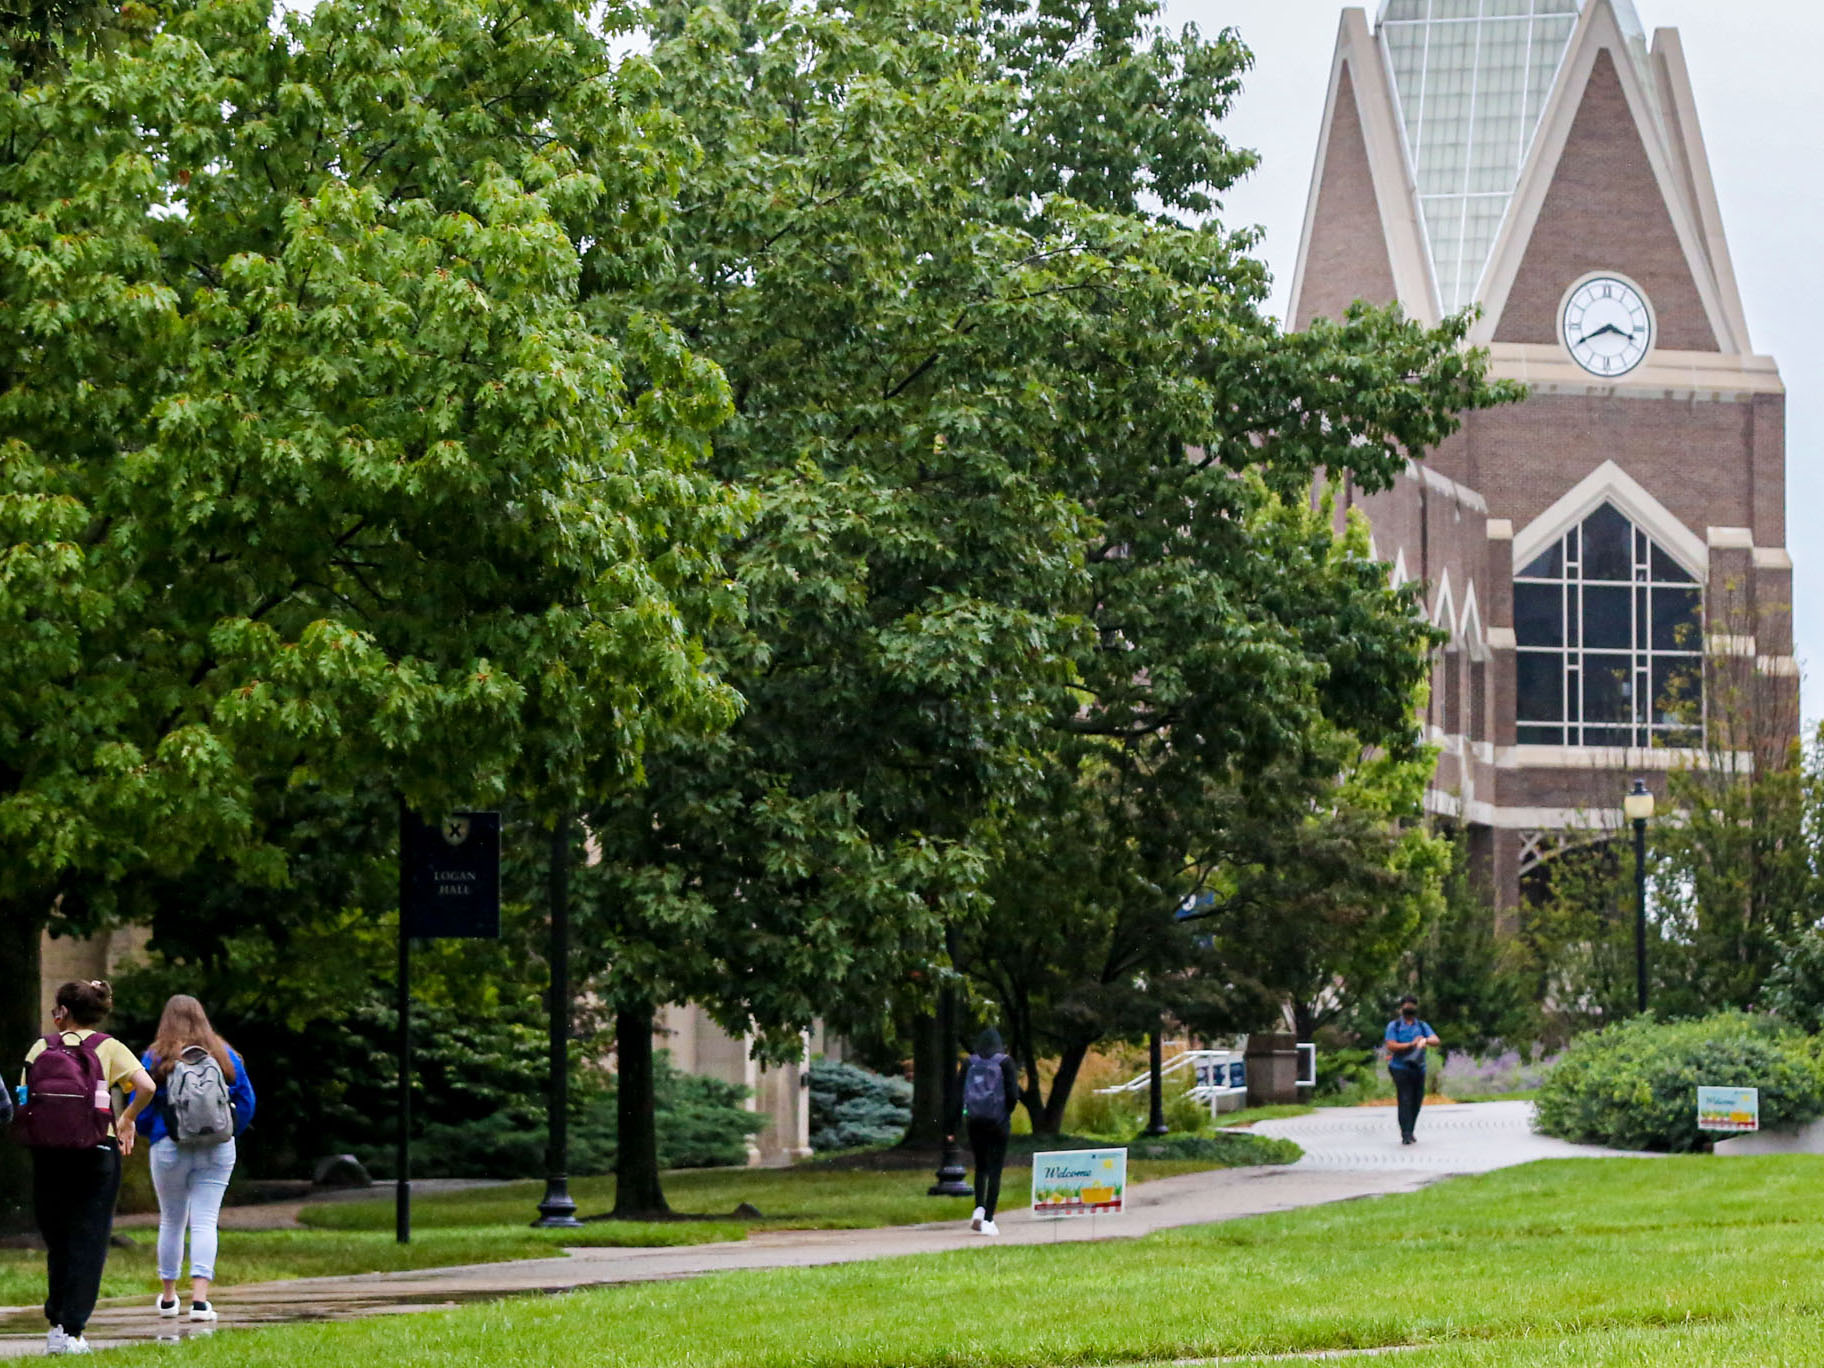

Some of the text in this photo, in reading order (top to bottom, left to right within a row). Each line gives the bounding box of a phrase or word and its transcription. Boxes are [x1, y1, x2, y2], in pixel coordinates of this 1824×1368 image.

[433, 871, 477, 881] LOGAN
[439, 885, 472, 895] HALL
[1044, 1166, 1092, 1179] Welcome
